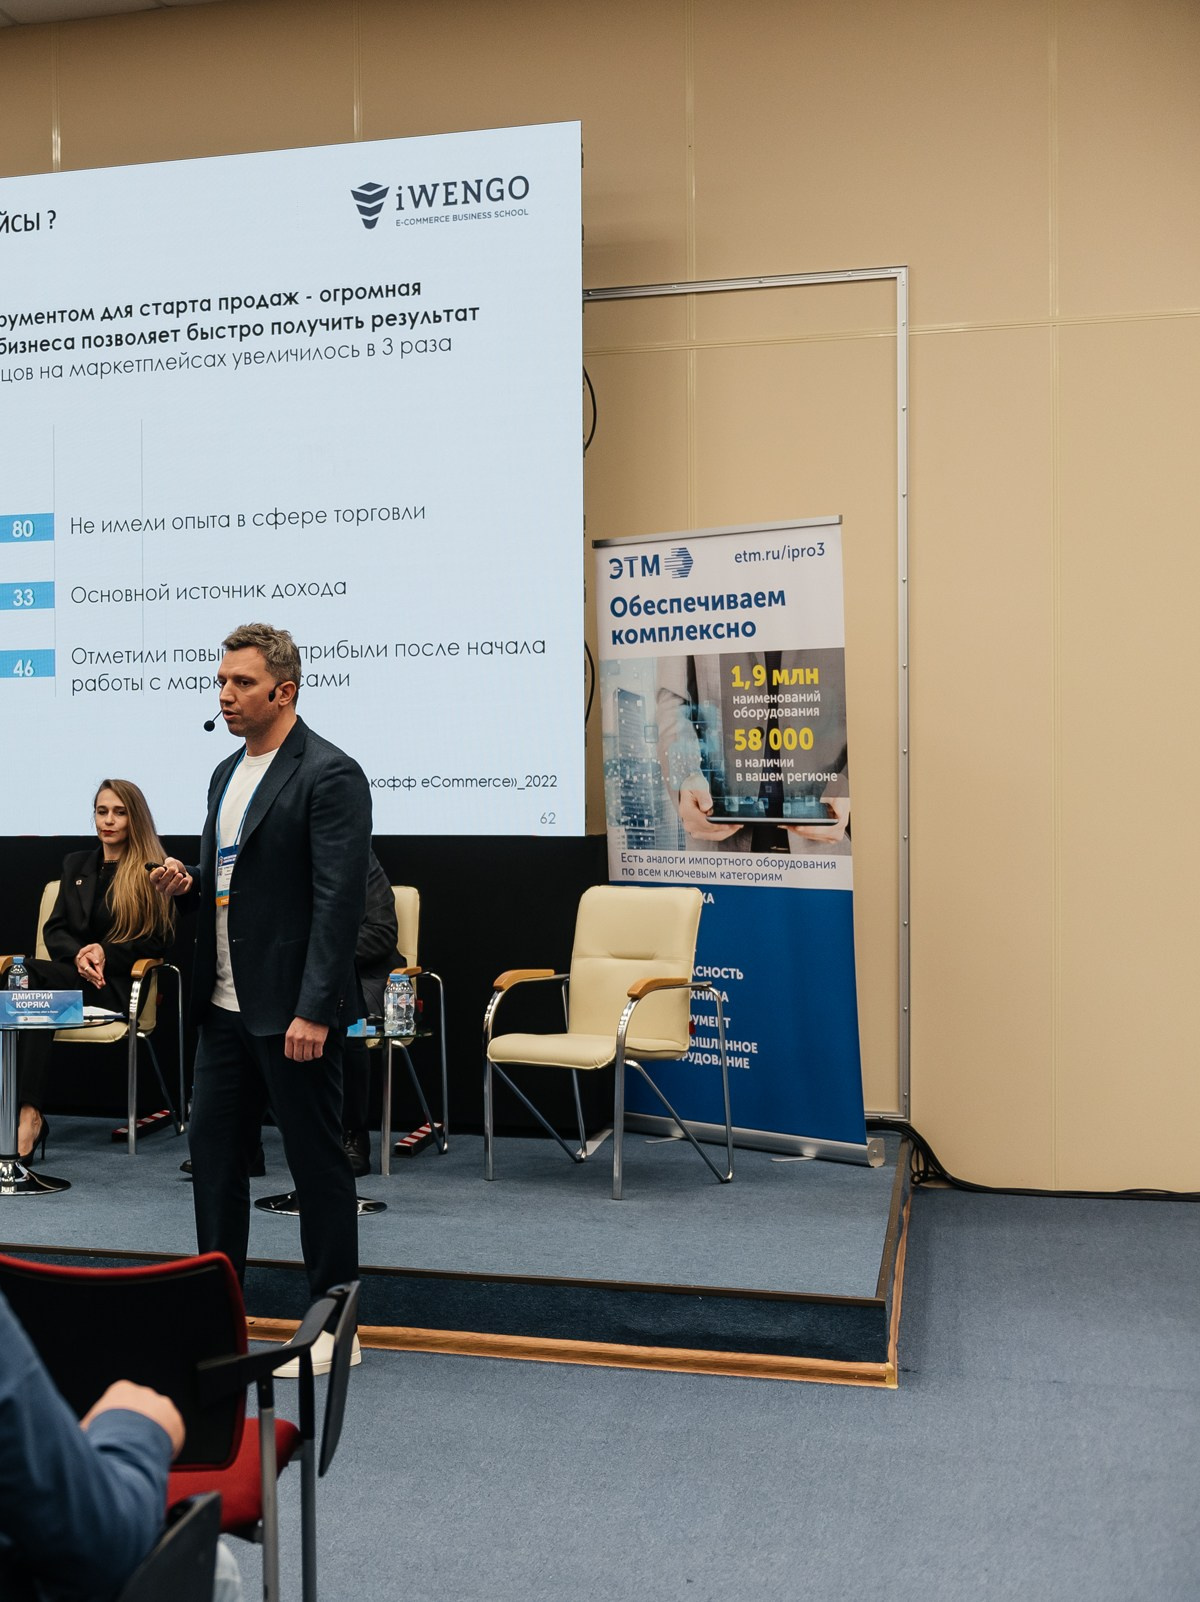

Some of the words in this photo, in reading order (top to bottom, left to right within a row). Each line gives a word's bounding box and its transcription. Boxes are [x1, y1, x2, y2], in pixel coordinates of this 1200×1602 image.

[396, 175, 530, 211] iWENGO
[47, 209, 58, 230] ?
[396, 214, 450, 227] E-COMMERCE
[452, 211, 491, 223] BUSINESS
[494, 208, 529, 221] SCHOOL
[100, 304, 133, 324] для
[139, 297, 212, 321] старта
[218, 289, 300, 316] продаж
[319, 282, 422, 308] огромная
[81, 327, 181, 351] позволяет
[187, 320, 265, 347] быстро
[270, 312, 365, 342] получить
[371, 305, 480, 334] результат
[40, 363, 64, 379] на
[69, 348, 227, 380] маркетплейсах
[232, 341, 360, 371] увеличилось
[366, 342, 376, 357] в
[382, 337, 394, 357] 3
[400, 335, 452, 361] раза
[11, 519, 35, 538] 80
[70, 517, 95, 535] Не
[101, 514, 166, 534] имели
[171, 511, 231, 531] опыта
[237, 512, 247, 528] в
[251, 506, 328, 530] сфере
[333, 504, 426, 527] торговли
[734, 542, 826, 564] etm.ru/ipro3
[609, 554, 661, 580] ЭТМ
[12, 588, 35, 606] 33
[70, 582, 171, 605] Основной
[176, 581, 267, 600] источник
[271, 577, 348, 599] дохода
[609, 589, 787, 618] Обеспечиваем
[611, 620, 757, 646] комплексно
[70, 646, 167, 666] Отметили
[298, 639, 389, 663] прибыли
[394, 639, 461, 659] после
[466, 637, 546, 657] начала
[12, 659, 35, 677] 46
[731, 664, 767, 690] 1,9
[771, 667, 820, 687] млн
[71, 672, 144, 696] работы
[149, 676, 161, 690] с
[732, 689, 821, 705] наименований
[732, 705, 820, 720] оборудования
[733, 729, 763, 751] 58
[768, 727, 814, 751] 000
[735, 759, 742, 768] в
[744, 758, 794, 768] наличии
[736, 773, 743, 782] в
[745, 772, 785, 782] вашем
[787, 771, 838, 784] регионе
[539, 812, 556, 825] 62
[620, 852, 644, 865] Есть
[646, 854, 686, 866] аналоги
[688, 856, 753, 870] импортного
[755, 857, 837, 871] оборудования
[621, 867, 635, 876] по
[637, 868, 661, 877] всем
[663, 869, 717, 880] ключевым
[719, 870, 783, 882] категориям
[15, 1001, 50, 1009] КОРЯКА
